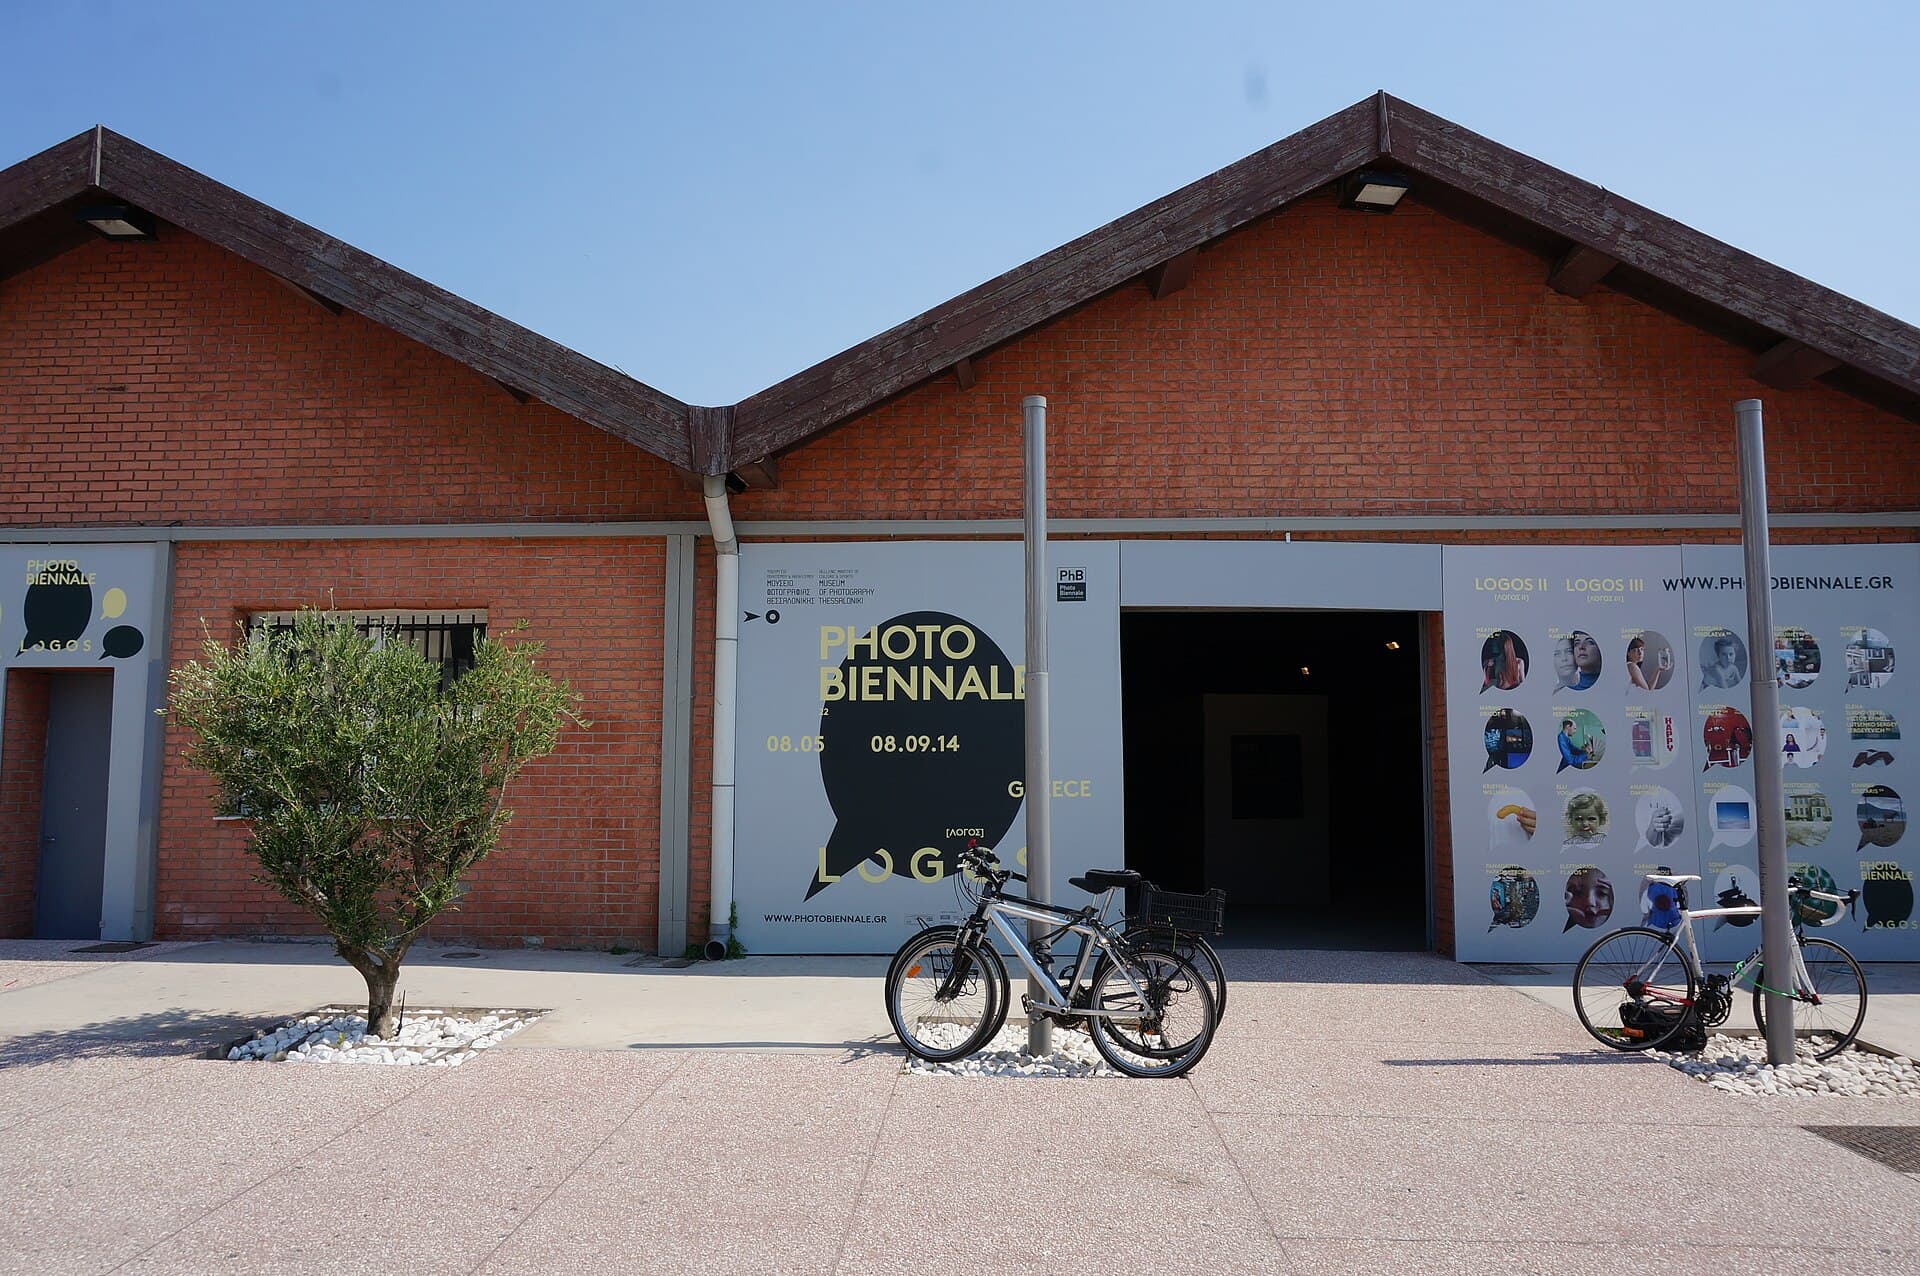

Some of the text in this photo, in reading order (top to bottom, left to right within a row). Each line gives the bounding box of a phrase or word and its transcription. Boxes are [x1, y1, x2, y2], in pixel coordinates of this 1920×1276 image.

[27, 560, 78, 572] PHOTO
[26, 573, 96, 585] BIENNALE
[1060, 570, 1084, 581] PhB
[1475, 577, 1548, 591] LOGOS II
[1566, 578, 1644, 592] LOGOS III
[1662, 576, 1894, 591] WWW.PHOBIENNALE.GR
[818, 588, 875, 596] OF PHOTOGRAPHY
[819, 597, 864, 605] THESSALONIKI
[20, 640, 91, 652] LOGOS
[820, 624, 976, 660] PHOTO
[1664, 717, 1674, 752] HAPPY
[767, 735, 960, 753] 08.05 08.09.14
[1007, 780, 1092, 798] GECE
[945, 828, 985, 839] [ΛΟΓΟΣ]
[818, 846, 1026, 884] LOG
[1859, 861, 1898, 870] PHOTO
[1860, 871, 1913, 880] BIENNALE
[764, 914, 887, 924] WWW.PHOTOBIENNALE.GR
[1865, 920, 1918, 929] LOGOS
